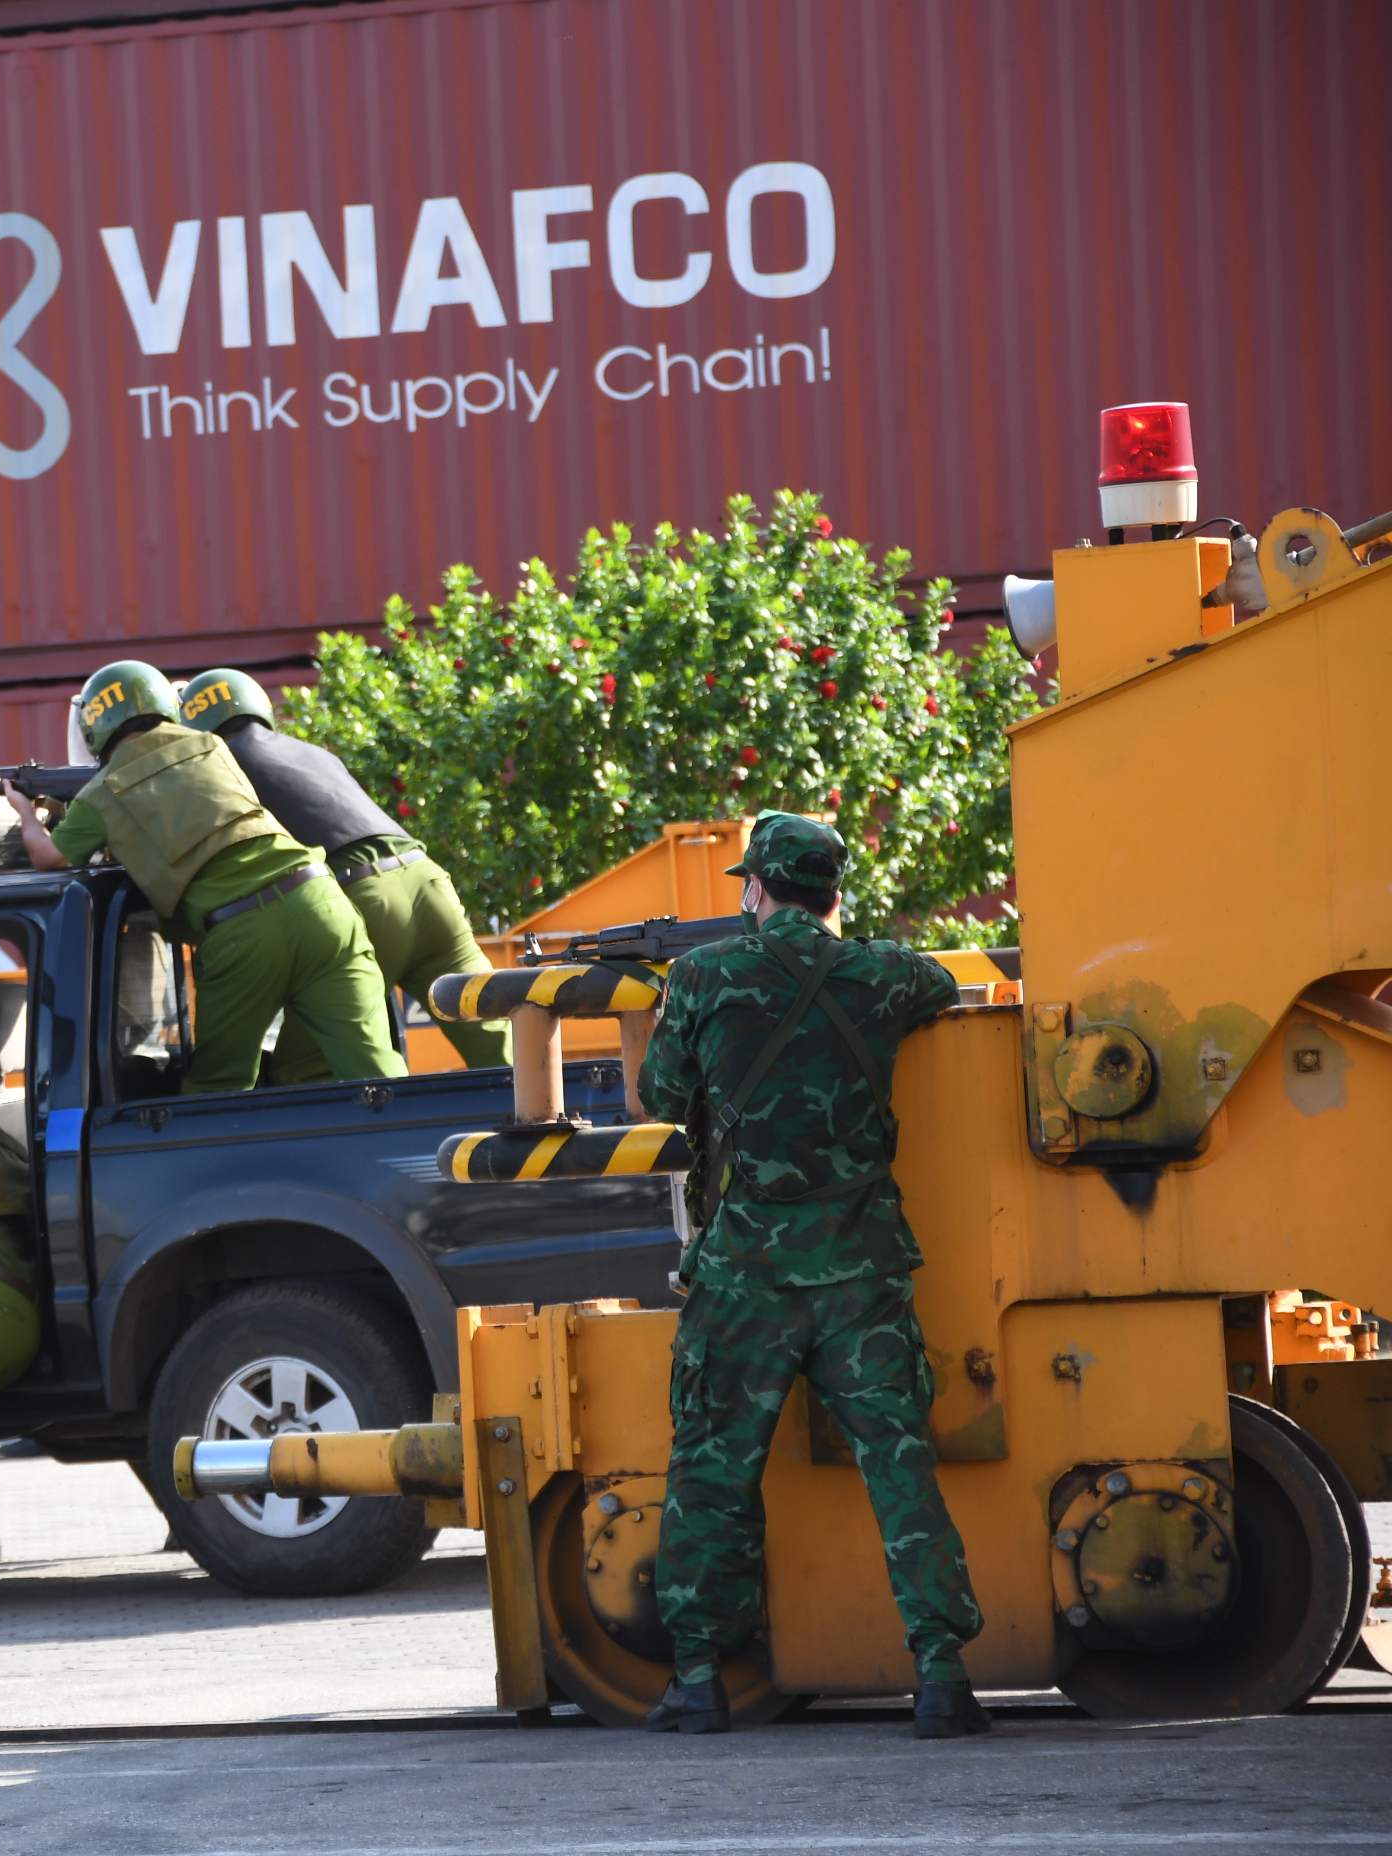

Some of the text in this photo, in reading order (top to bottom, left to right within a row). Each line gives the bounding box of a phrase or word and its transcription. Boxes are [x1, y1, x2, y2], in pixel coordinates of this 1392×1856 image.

[99, 161, 836, 356] VINAFCO
[127, 327, 832, 440] Think Supply Chain!
[84, 680, 126, 726] CSTT
[183, 680, 232, 721] CSTT
